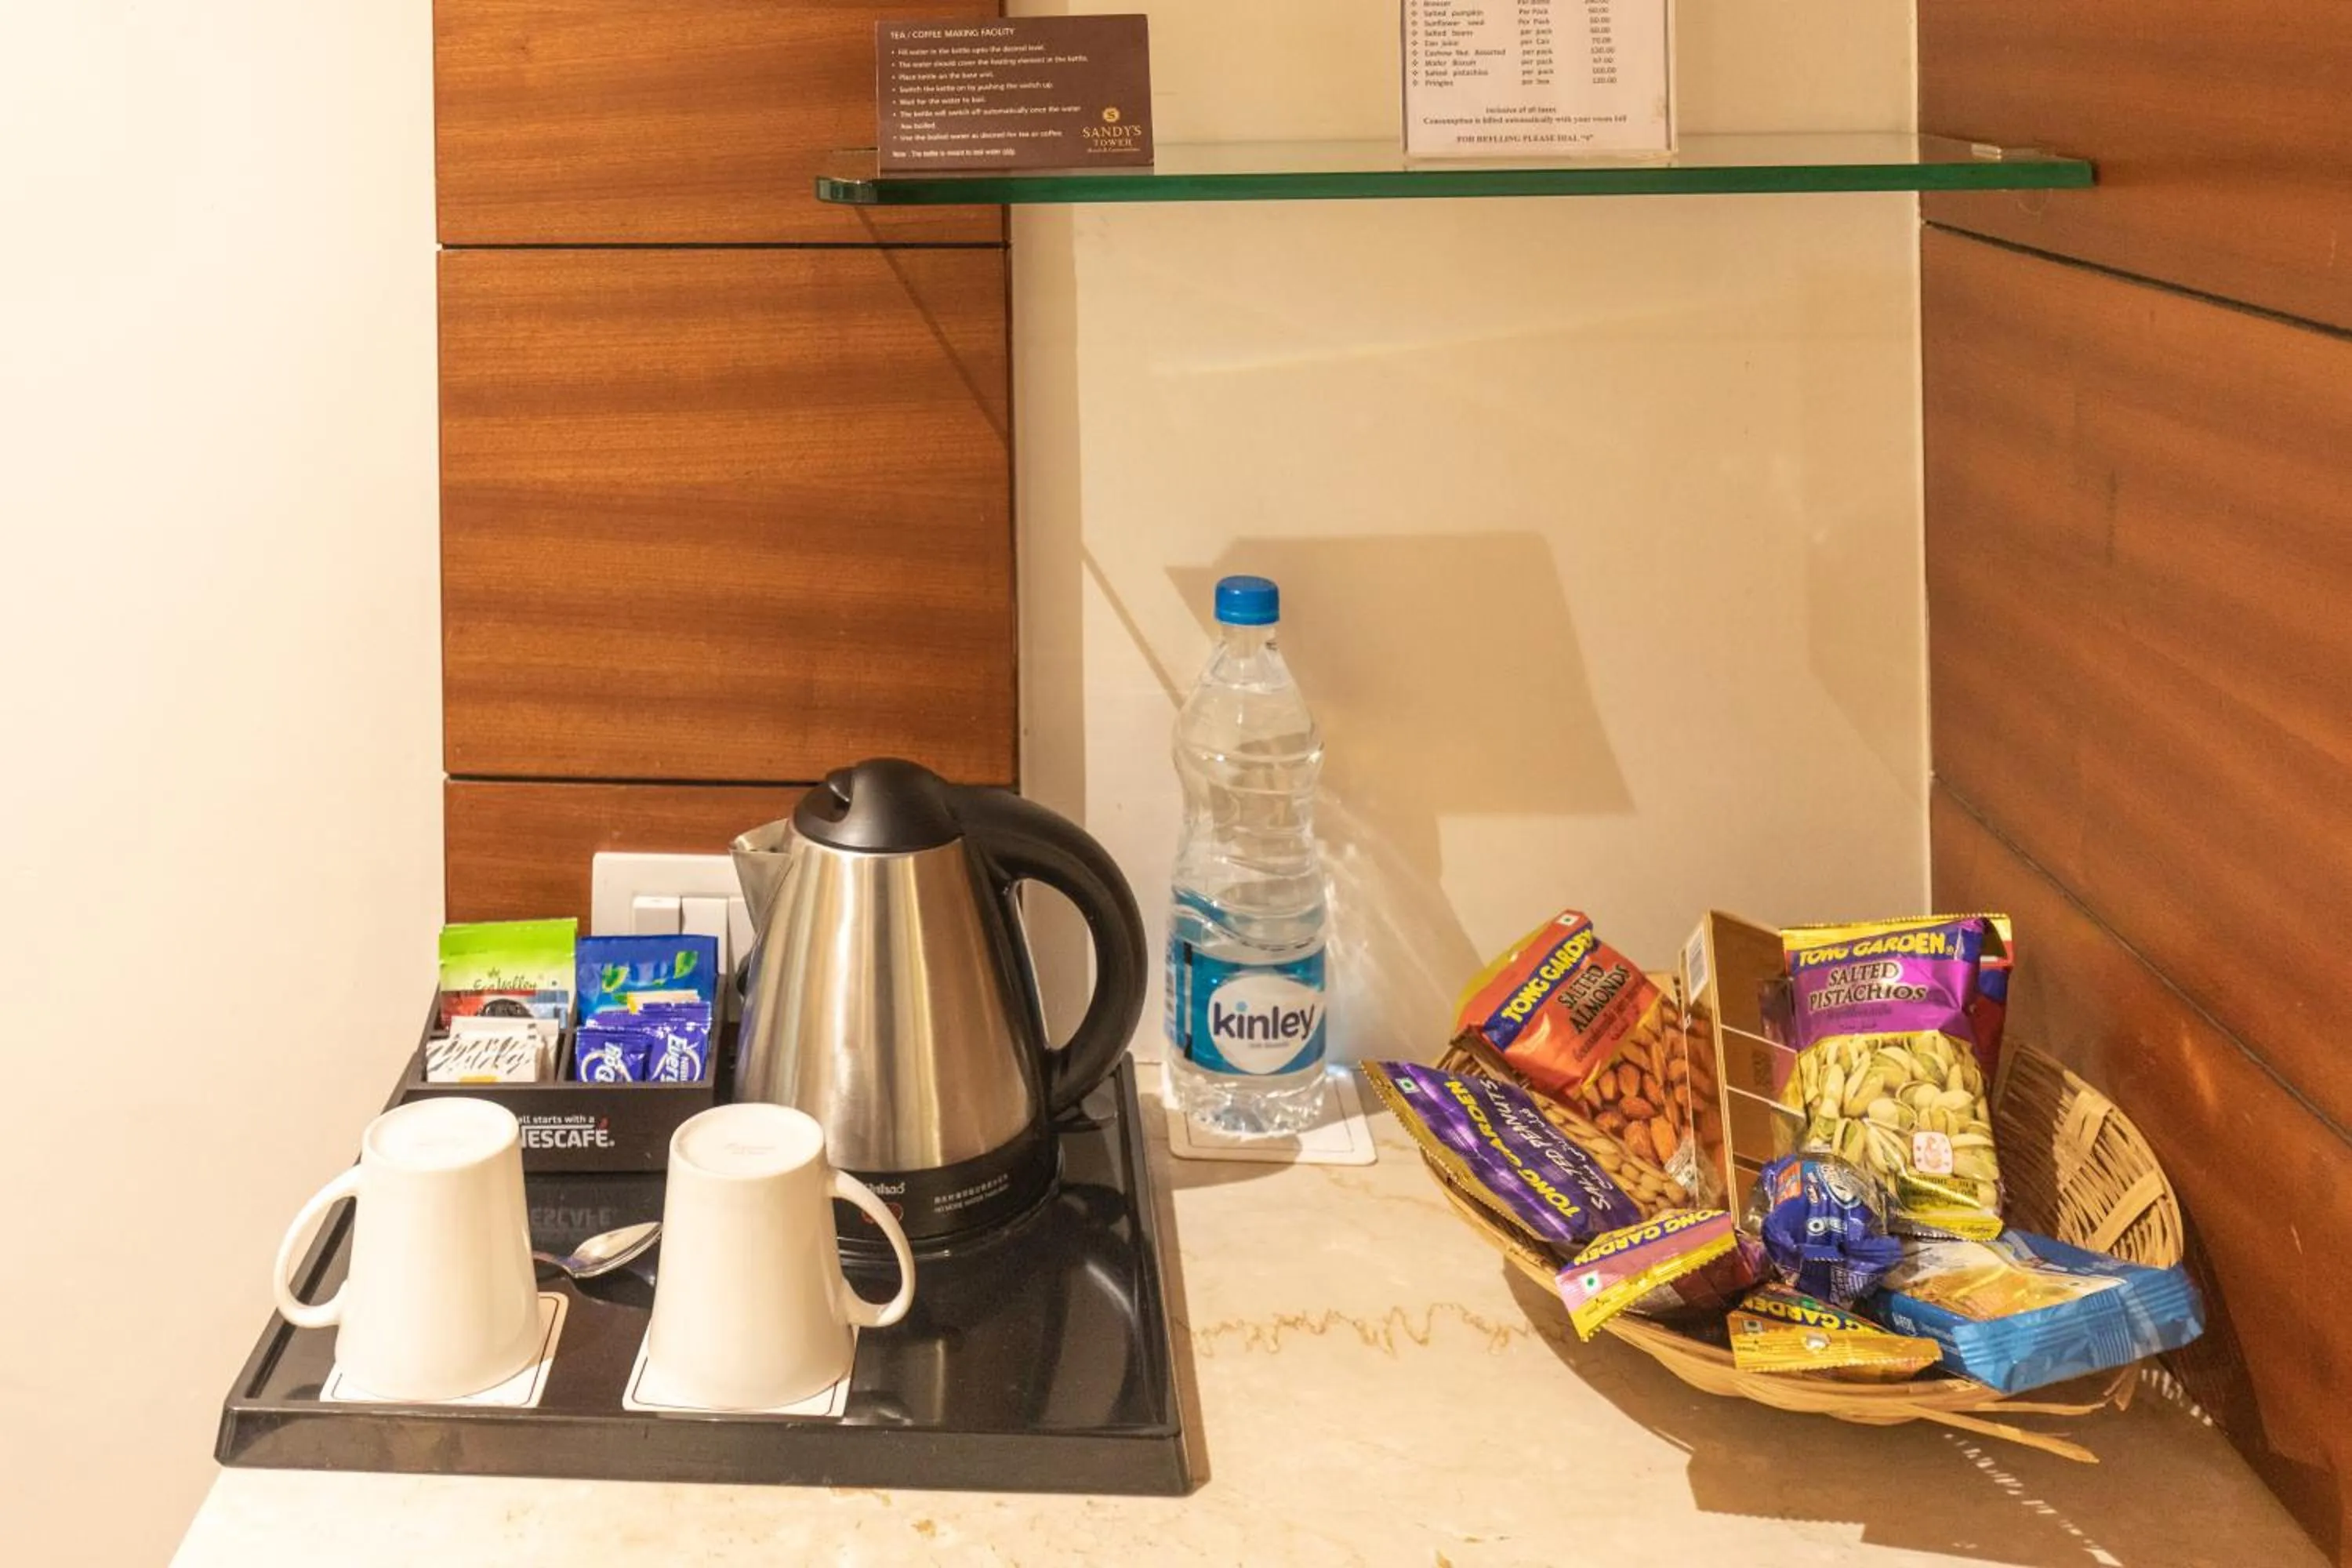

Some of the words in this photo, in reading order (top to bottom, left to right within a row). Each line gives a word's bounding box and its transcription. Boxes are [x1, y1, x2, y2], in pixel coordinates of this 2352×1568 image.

[912, 30, 942, 38] COFFEE
[981, 27, 1015, 36] FACILITY
[1082, 125, 1142, 139] SANDY'S
[1093, 138, 1133, 147] TOWER
[1799, 946, 1850, 967] TONG
[1853, 932, 1946, 956] GARDEN
[1557, 964, 1606, 1010] SALTED
[1828, 961, 1900, 988] SALTED
[1501, 977, 1551, 1024] TONG
[1568, 964, 1632, 1036] ALMONDS
[1808, 983, 1927, 1010] PISTACHIOS
[1213, 1001, 1316, 1041] kinley
[564, 1115, 586, 1123] with
[1479, 1077, 1553, 1149] PEANUTS
[1517, 1167, 1581, 1218] TONG
[1544, 1148, 1612, 1211] SALTED
[1573, 1225, 1662, 1266] GARDEN
